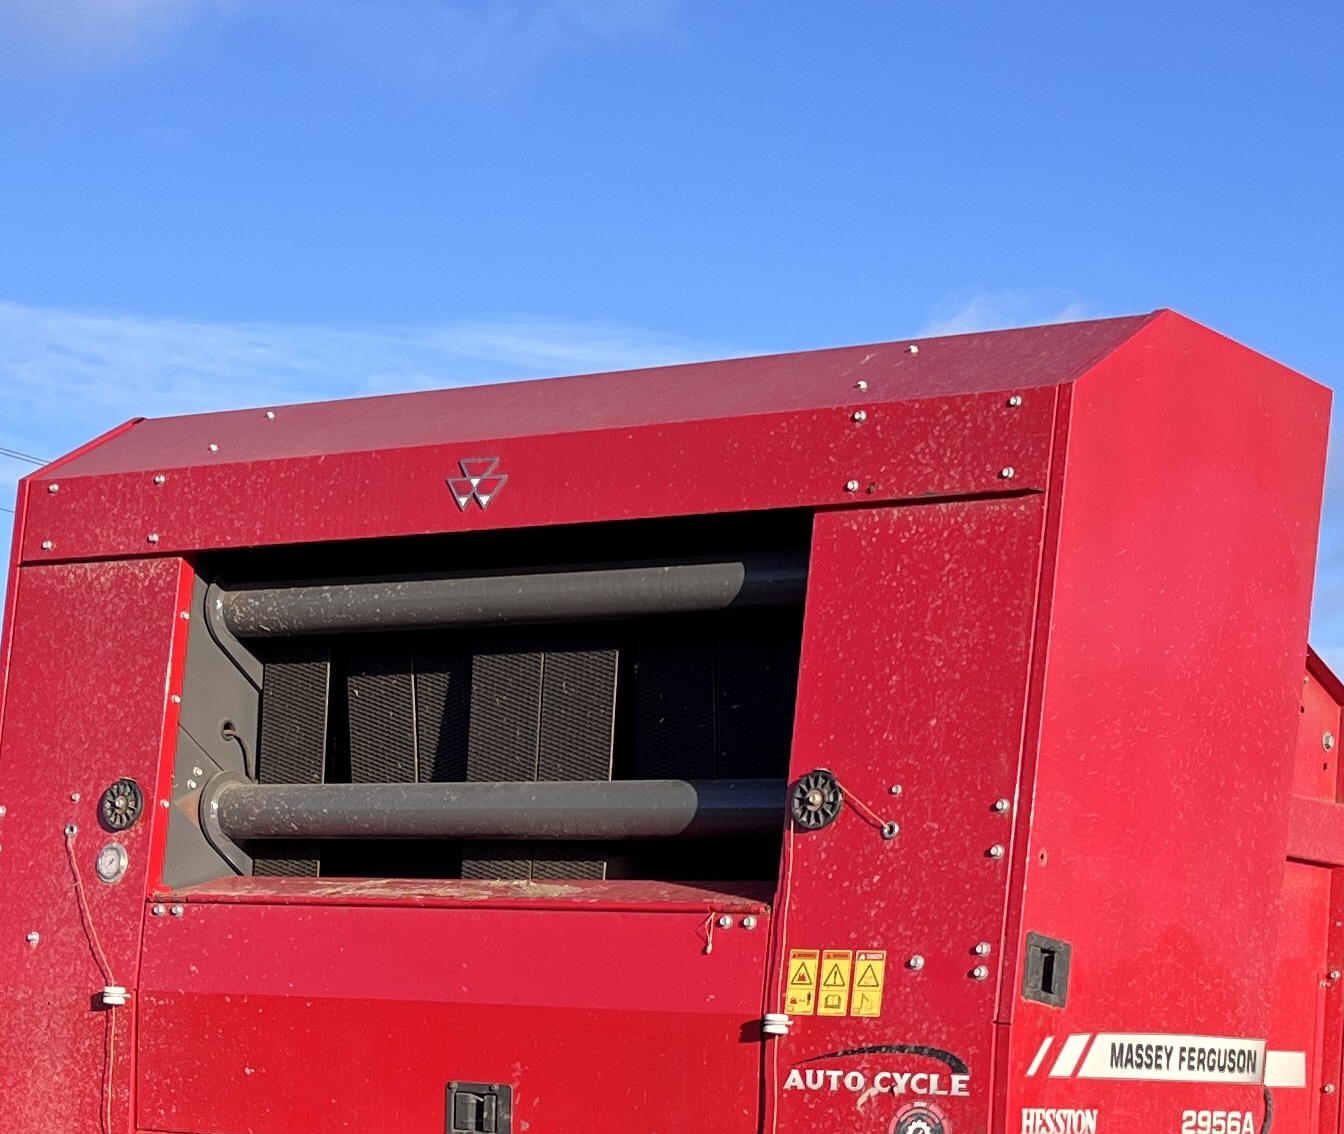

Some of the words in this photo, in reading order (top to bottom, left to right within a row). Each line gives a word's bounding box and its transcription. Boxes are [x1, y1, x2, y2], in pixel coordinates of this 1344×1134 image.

[1110, 1042, 1173, 1070] MASSEY
[1178, 1046, 1257, 1074] FERGUSON
[783, 1069, 864, 1092] AUTO
[874, 1072, 970, 1096] CYCLE
